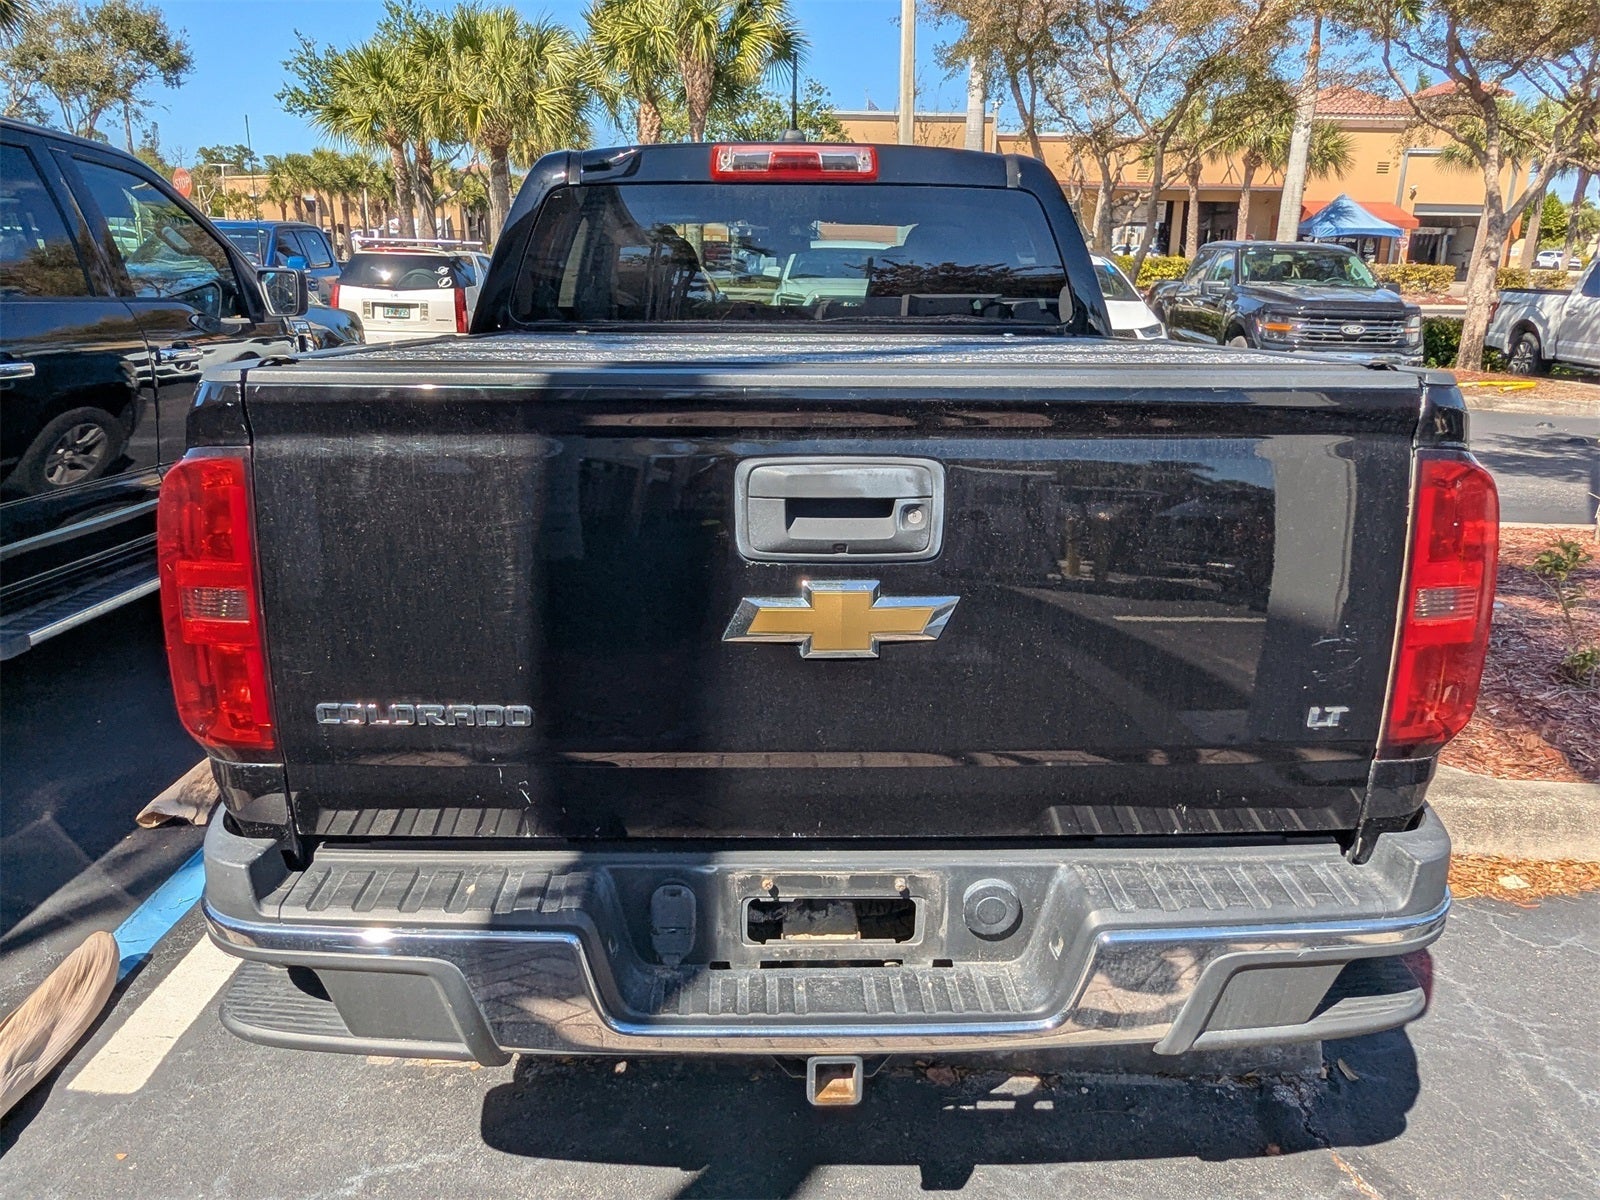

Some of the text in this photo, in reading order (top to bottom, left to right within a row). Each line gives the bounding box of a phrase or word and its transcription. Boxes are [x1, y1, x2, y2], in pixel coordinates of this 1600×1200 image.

[174, 176, 190, 189] STOP
[315, 702, 533, 727] COLORADO
[1307, 706, 1349, 727] LT
